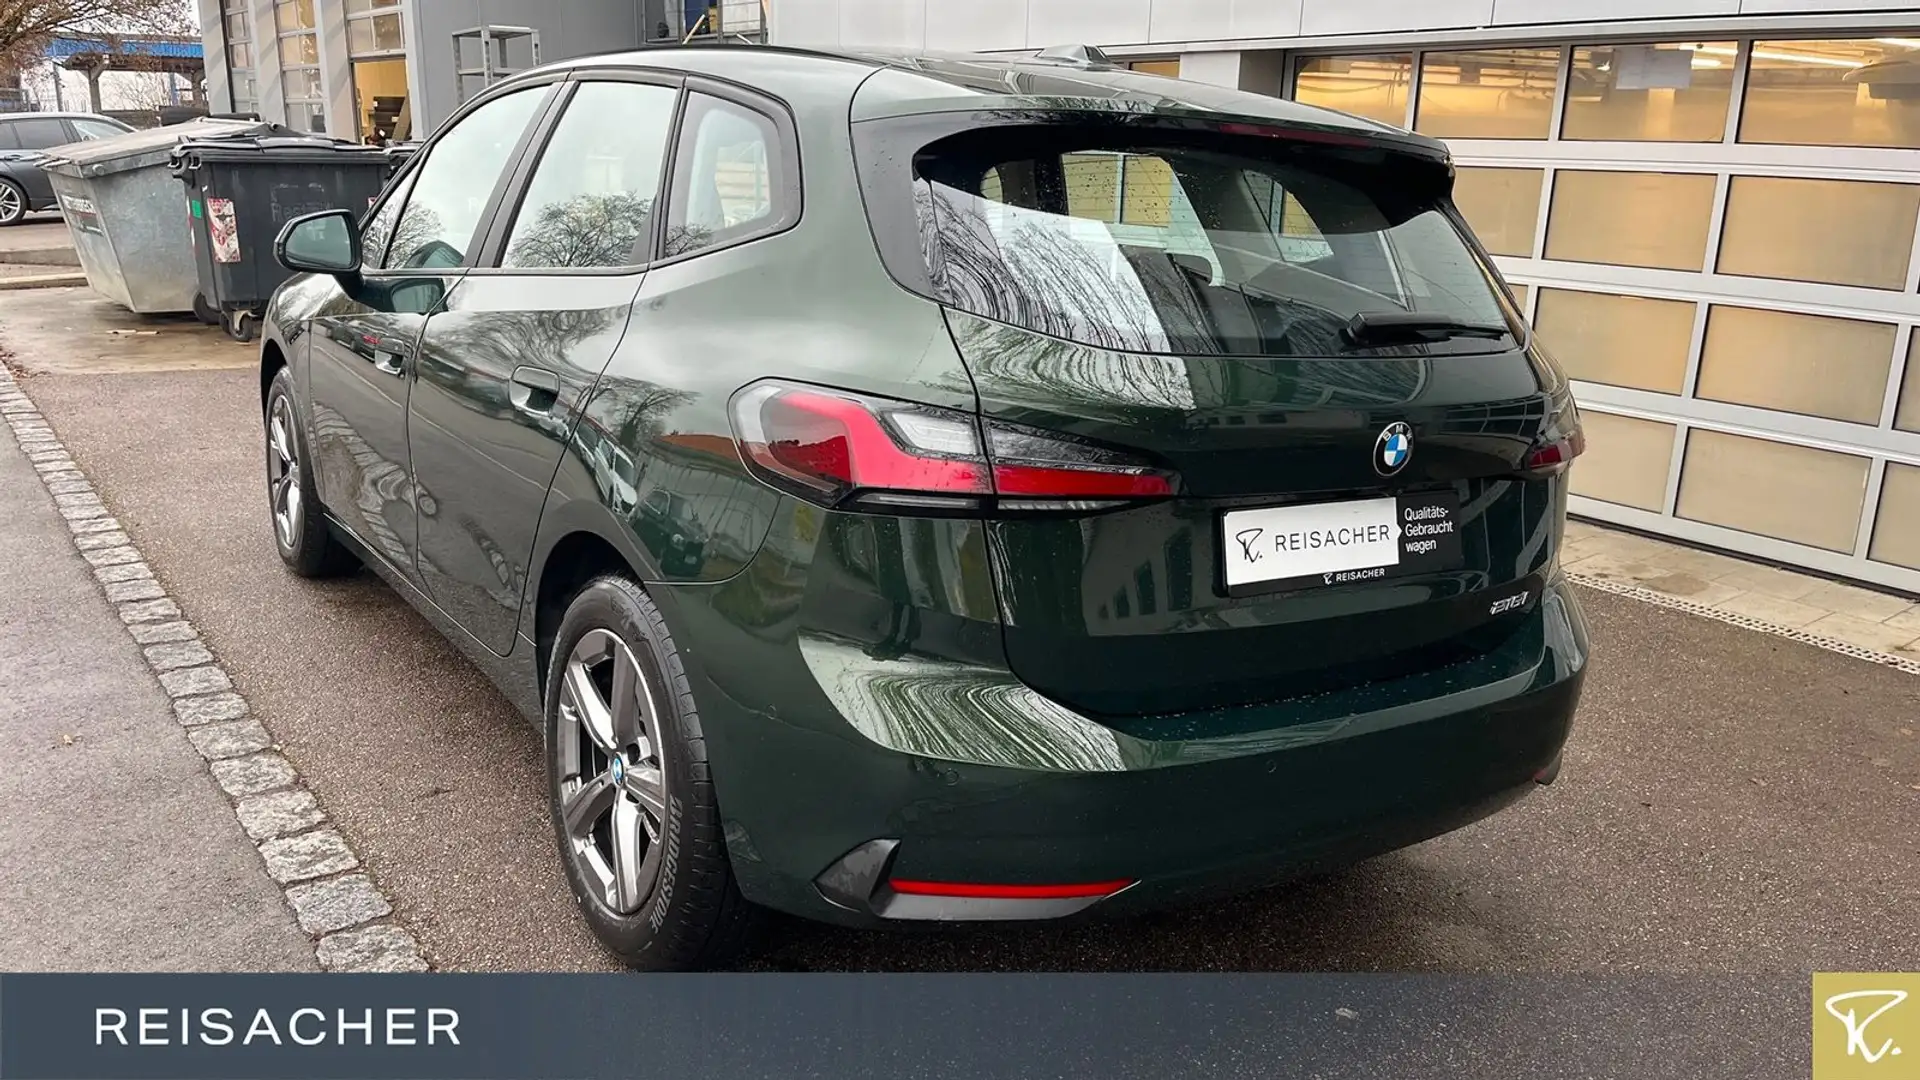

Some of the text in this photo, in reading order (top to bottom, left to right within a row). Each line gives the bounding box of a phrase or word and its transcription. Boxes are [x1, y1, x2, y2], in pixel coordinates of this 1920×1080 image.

[1404, 505, 1449, 521] Qualitäts-
[1405, 520, 1454, 537] Gebraucht
[1275, 524, 1390, 552] REISACHER
[1405, 539, 1437, 554] wagen
[1335, 567, 1386, 582] REISACHER
[649, 794, 683, 934] BRIDGESTONE
